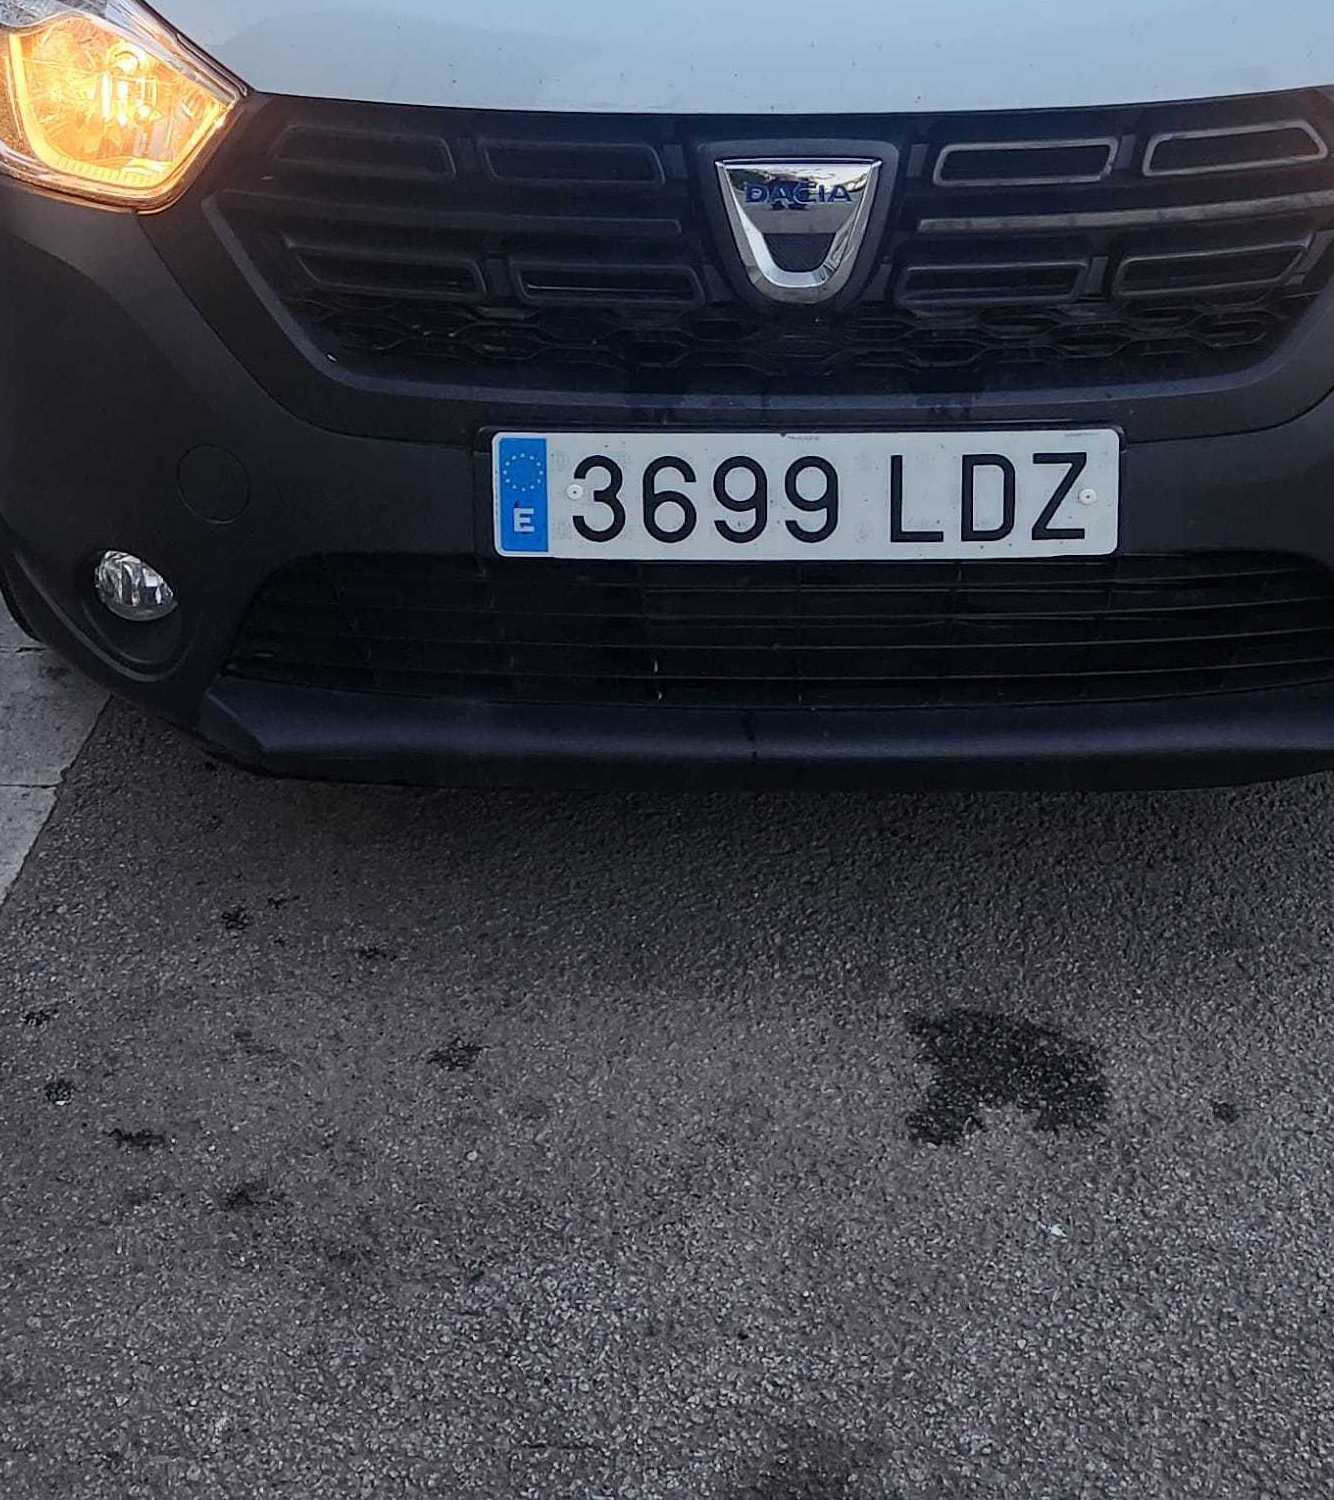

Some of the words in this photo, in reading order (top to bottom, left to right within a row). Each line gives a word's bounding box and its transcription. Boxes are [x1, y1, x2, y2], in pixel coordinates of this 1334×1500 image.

[746, 183, 853, 204] DACIA
[572, 454, 839, 544] 3699
[890, 452, 1088, 543] LDZ
[513, 507, 536, 533] E
